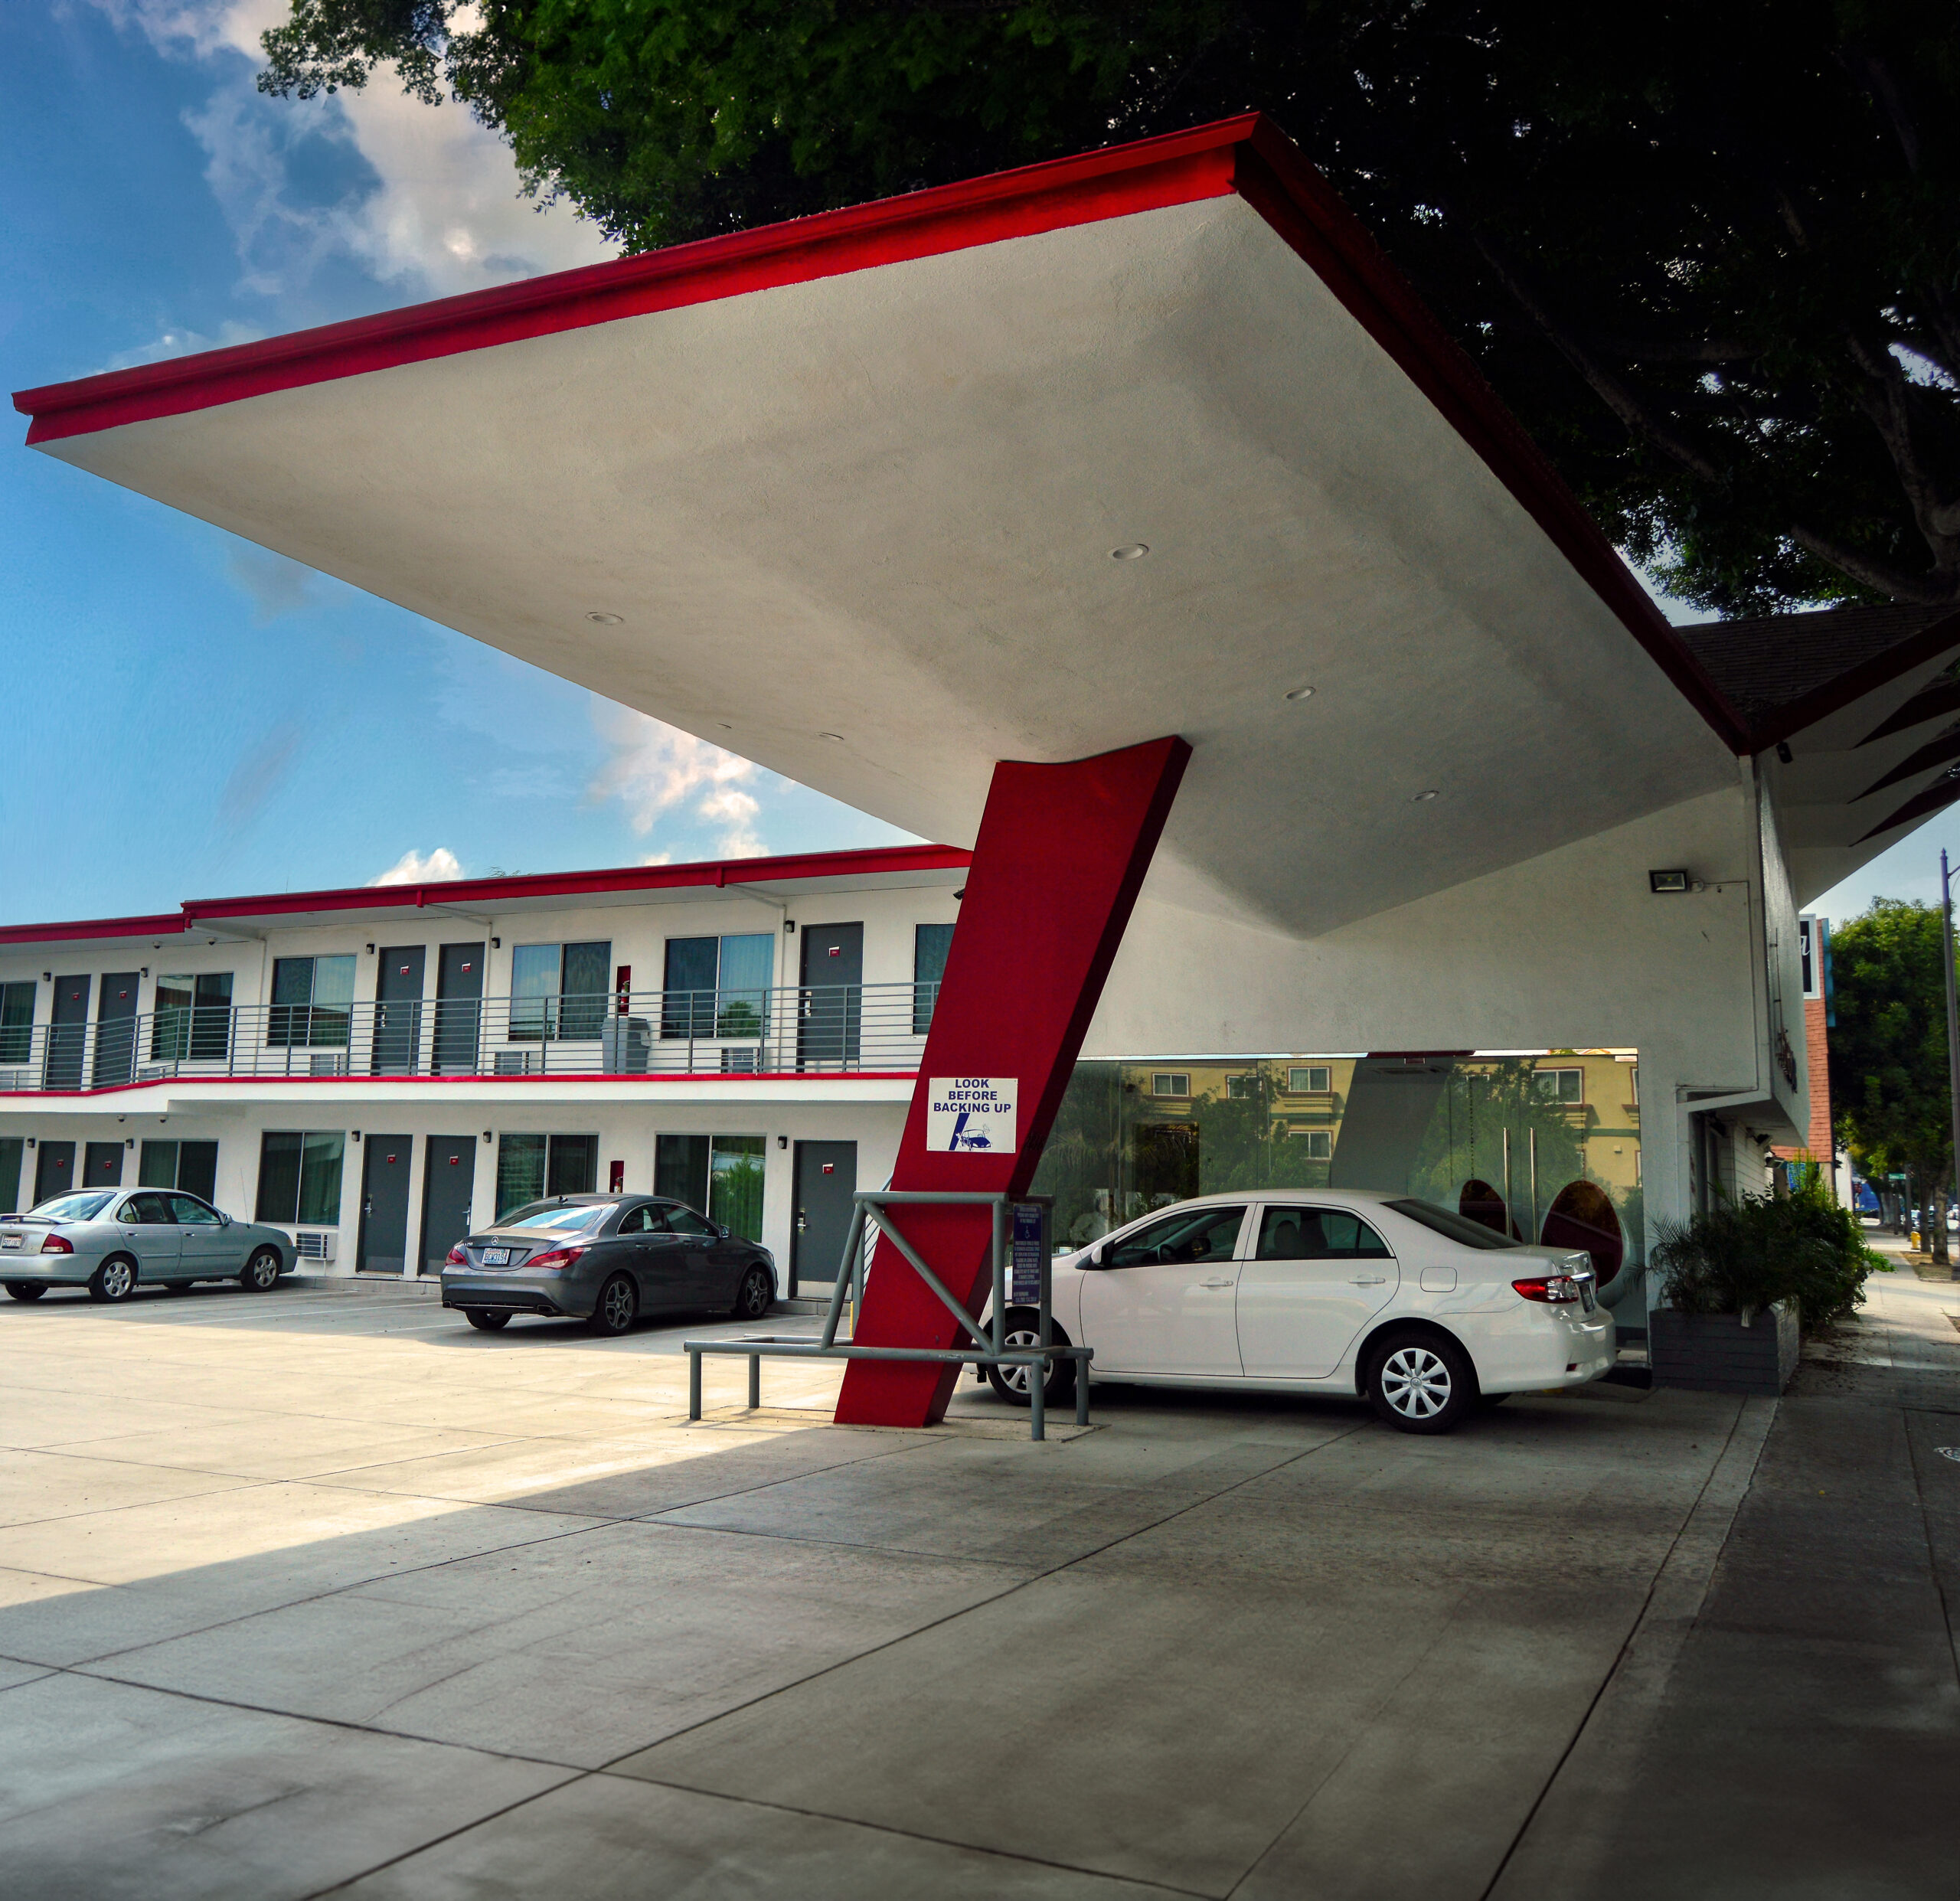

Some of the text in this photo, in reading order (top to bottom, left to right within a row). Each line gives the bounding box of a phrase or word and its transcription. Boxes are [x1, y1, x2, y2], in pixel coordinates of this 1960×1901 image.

[955, 1079, 990, 1089] LOOK
[948, 1091, 998, 1101] BEFORE
[933, 1102, 1011, 1113] BACKING UP
